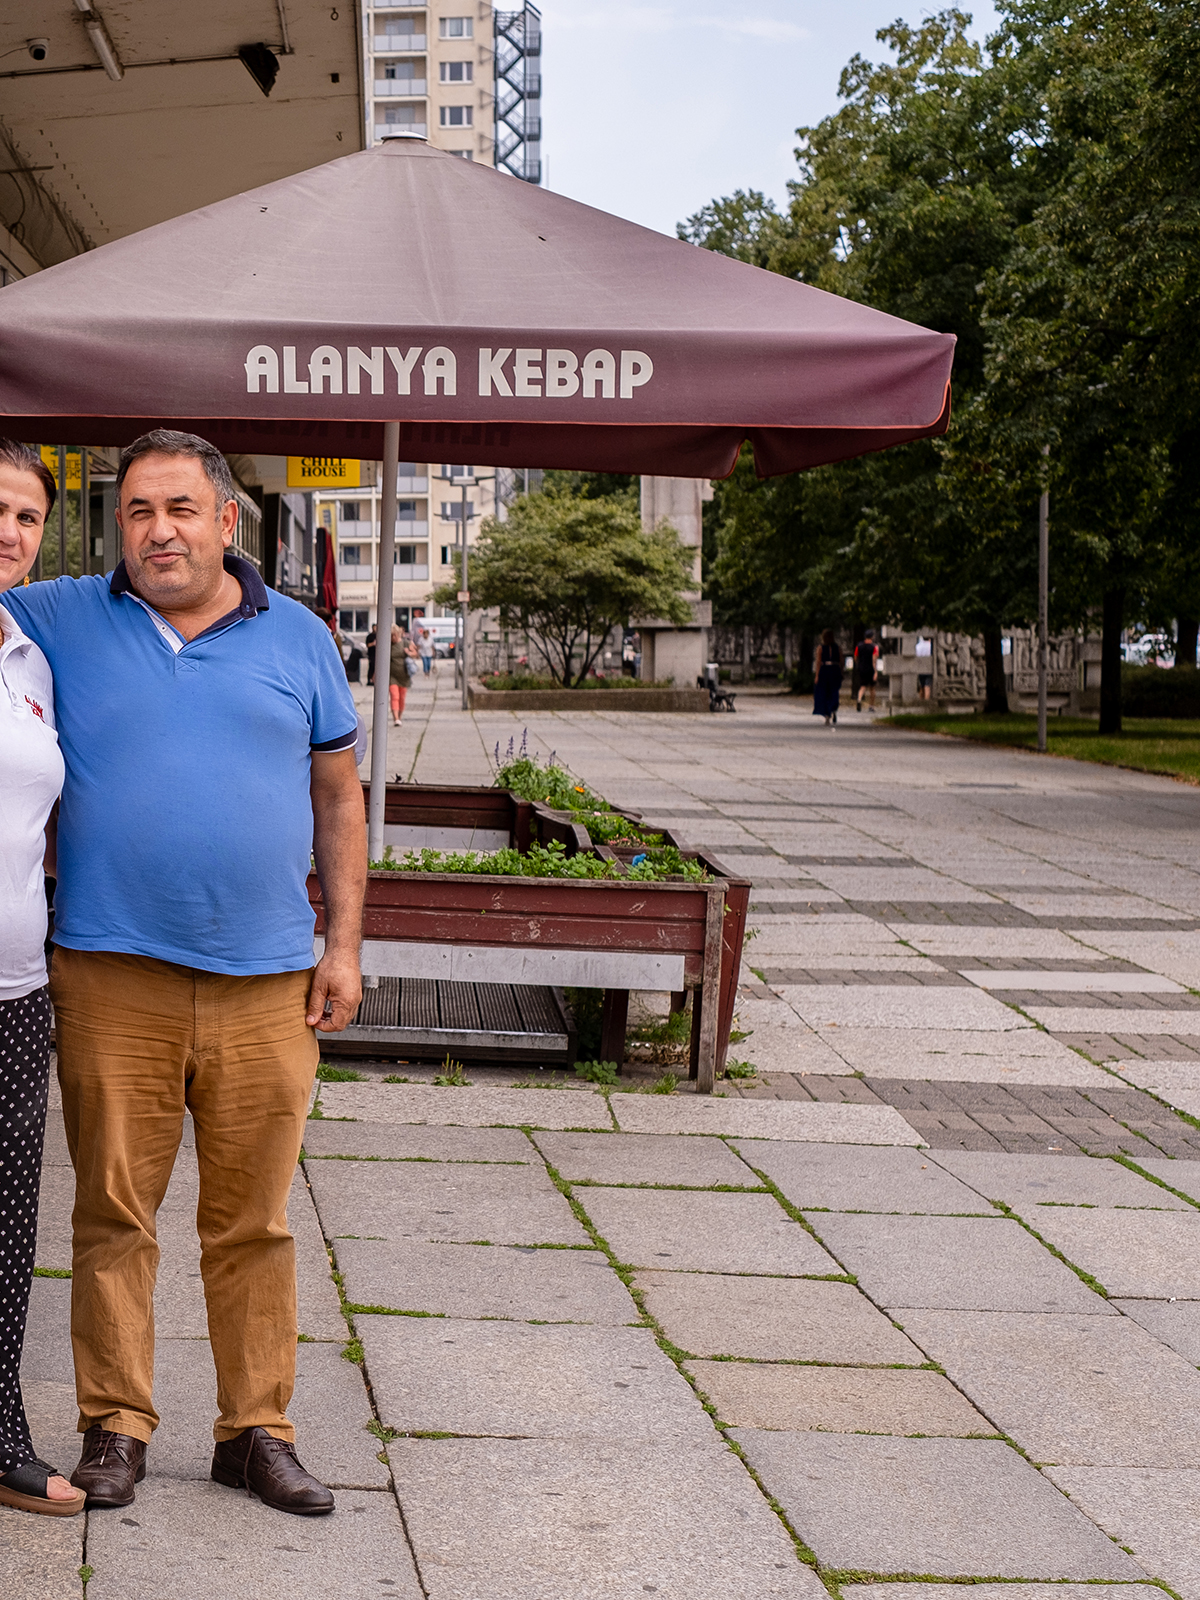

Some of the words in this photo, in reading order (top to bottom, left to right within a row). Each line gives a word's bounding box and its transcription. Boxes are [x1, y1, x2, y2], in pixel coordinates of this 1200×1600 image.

[244, 345, 457, 396] ALANYA
[478, 348, 654, 398] KEBAP
[301, 466, 346, 477] HOUSE
